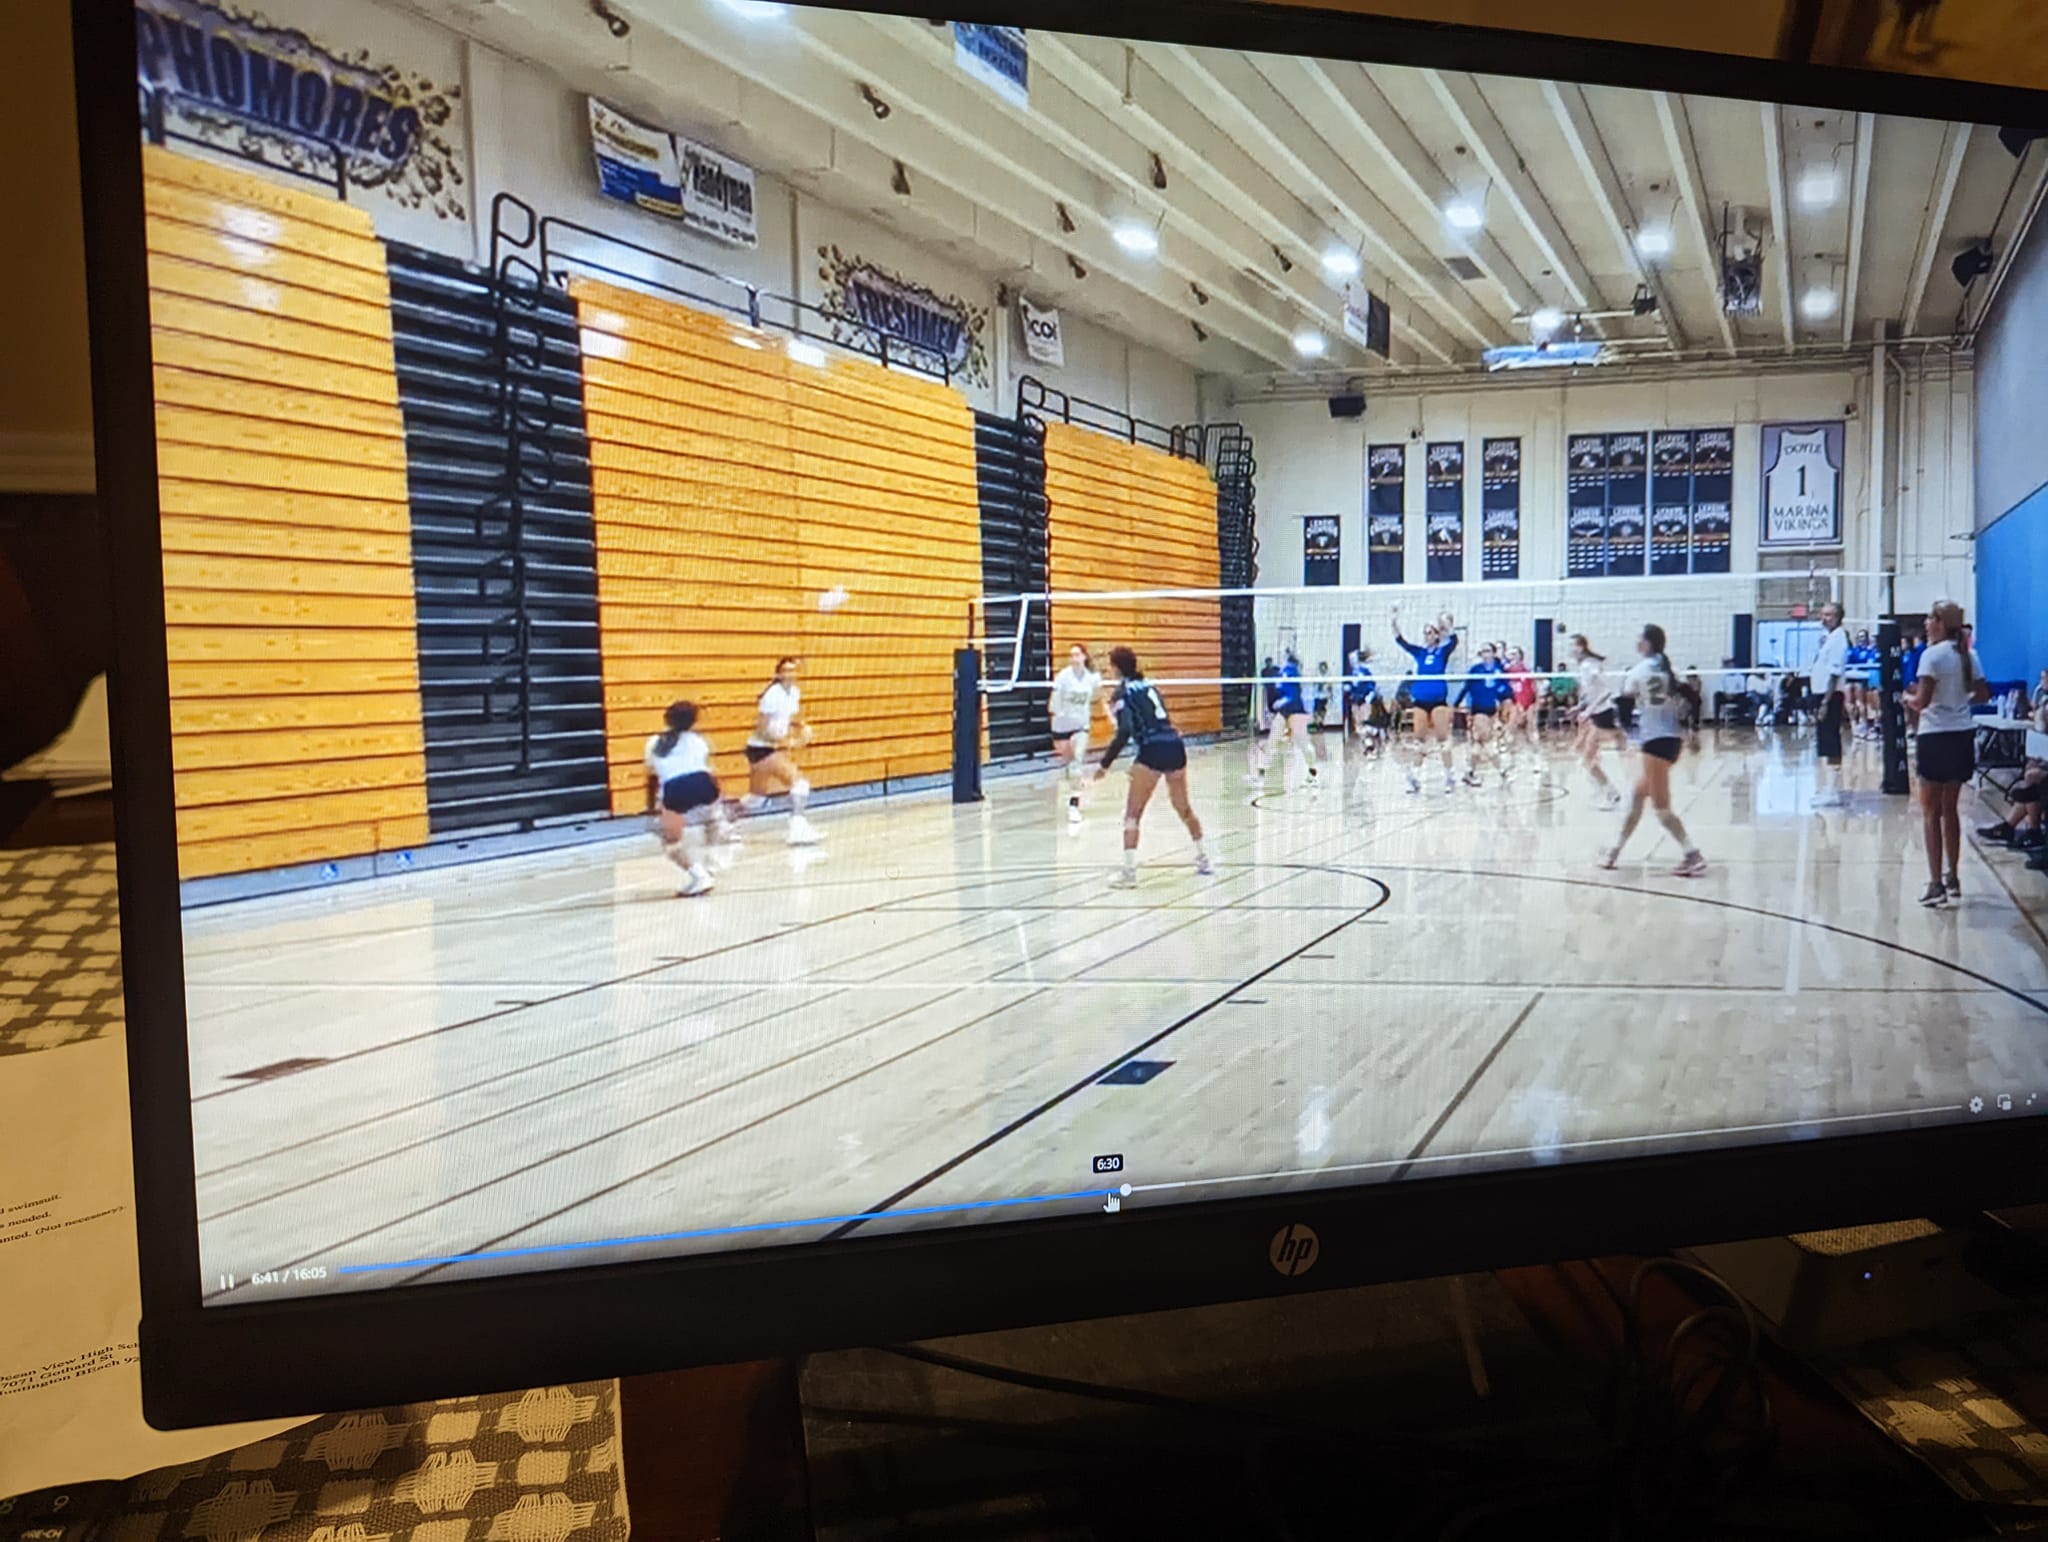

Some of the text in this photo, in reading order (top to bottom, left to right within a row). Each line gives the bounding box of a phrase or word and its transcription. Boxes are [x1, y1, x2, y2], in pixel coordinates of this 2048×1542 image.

[1784, 442, 1822, 456] DOYLE
[1797, 464, 1806, 497] 1
[1773, 503, 1829, 518] MARINA
[1774, 518, 1829, 532] VIKINGS
[1097, 1157, 1120, 1170] 6:30
[8, 1194, 62, 1213] swimsuit.
[8, 1211, 52, 1227] needed.
[35, 1223, 61, 1236] (Not
[1276, 1224, 1314, 1276] hp
[252, 1271, 279, 1285] 6:41
[294, 1267, 328, 1281] 16:05
[40, 1359, 96, 1380] Gothard
[100, 1353, 114, 1362] St
[42, 1358, 77, 1371] View
[81, 1346, 114, 1361] High
